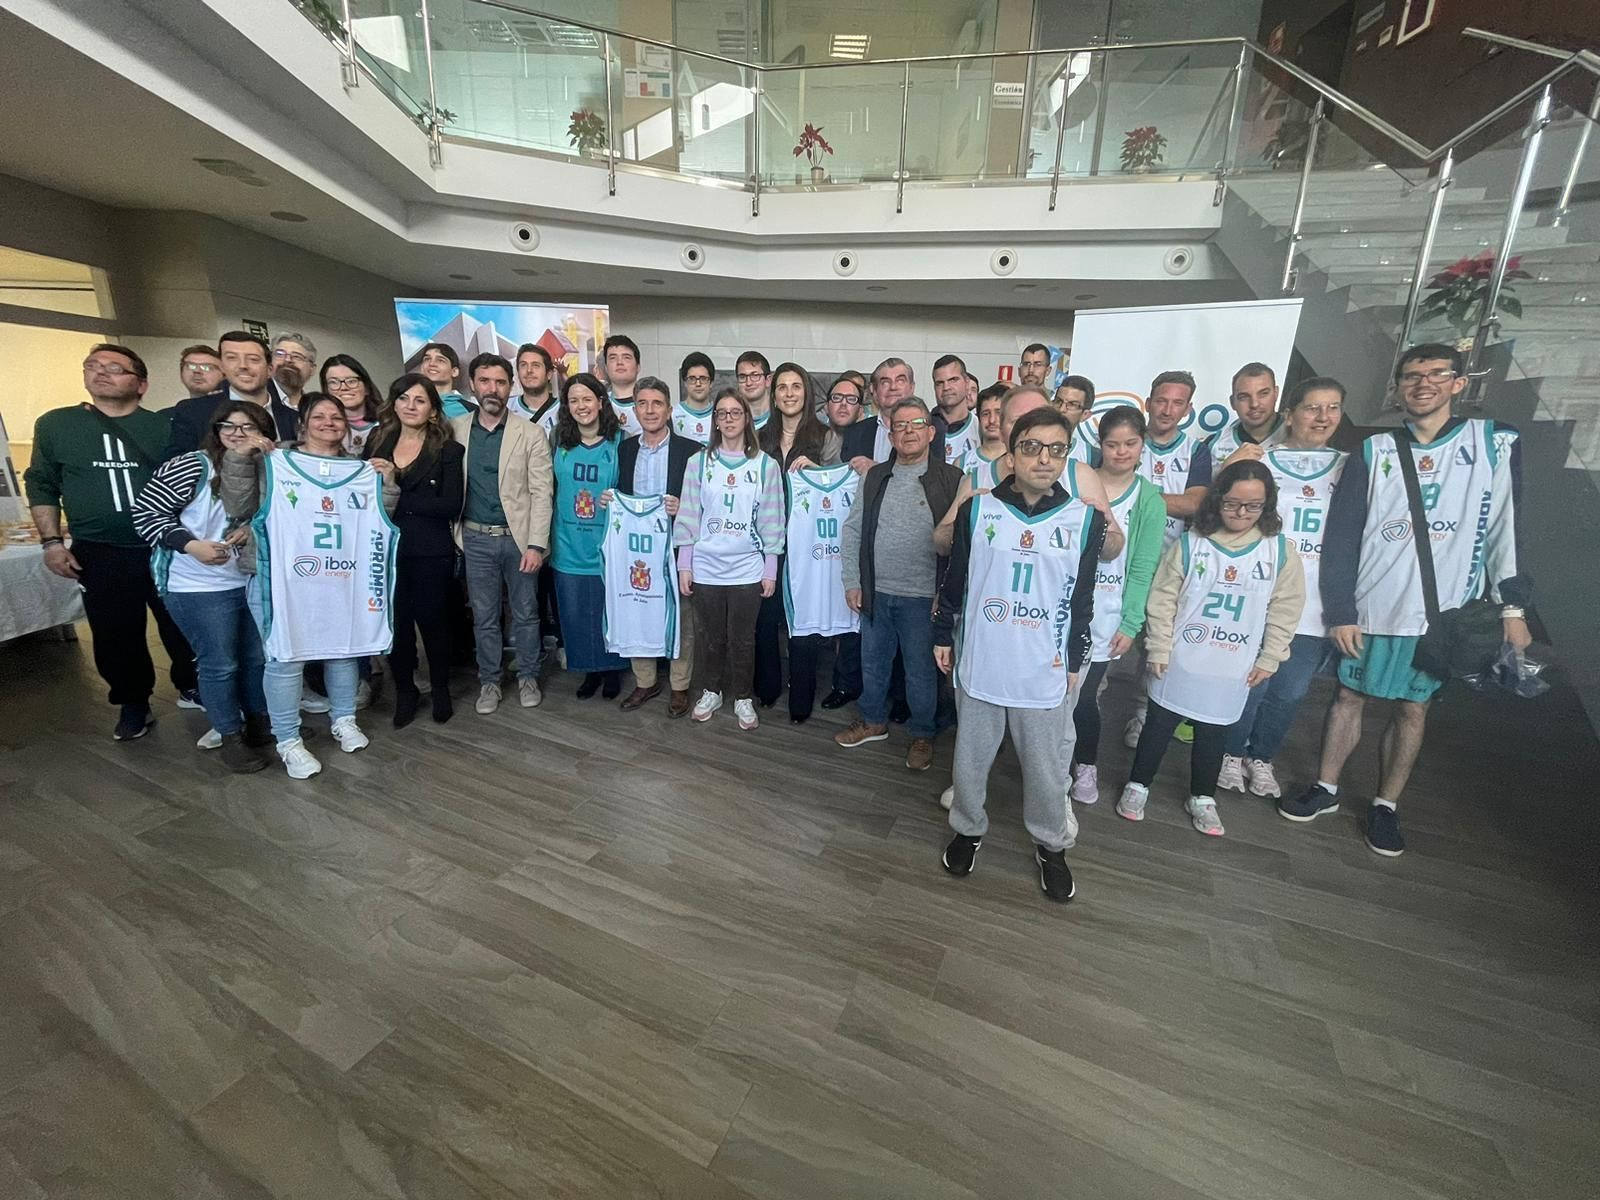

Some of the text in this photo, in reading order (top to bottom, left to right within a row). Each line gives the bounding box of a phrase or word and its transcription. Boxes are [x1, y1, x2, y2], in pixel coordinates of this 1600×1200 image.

[573, 462, 599, 483] 00
[723, 493, 735, 514] 4
[724, 518, 748, 532] ibox
[816, 517, 838, 539] 00
[1293, 506, 1323, 533] 16
[313, 522, 342, 550] 21
[628, 533, 653, 554] 00
[325, 556, 357, 570] ibox
[1011, 562, 1034, 594] 11
[1096, 571, 1123, 584] ibox
[1013, 601, 1049, 621] ibox
[1201, 592, 1246, 622] 24
[1211, 626, 1250, 645] ibox
